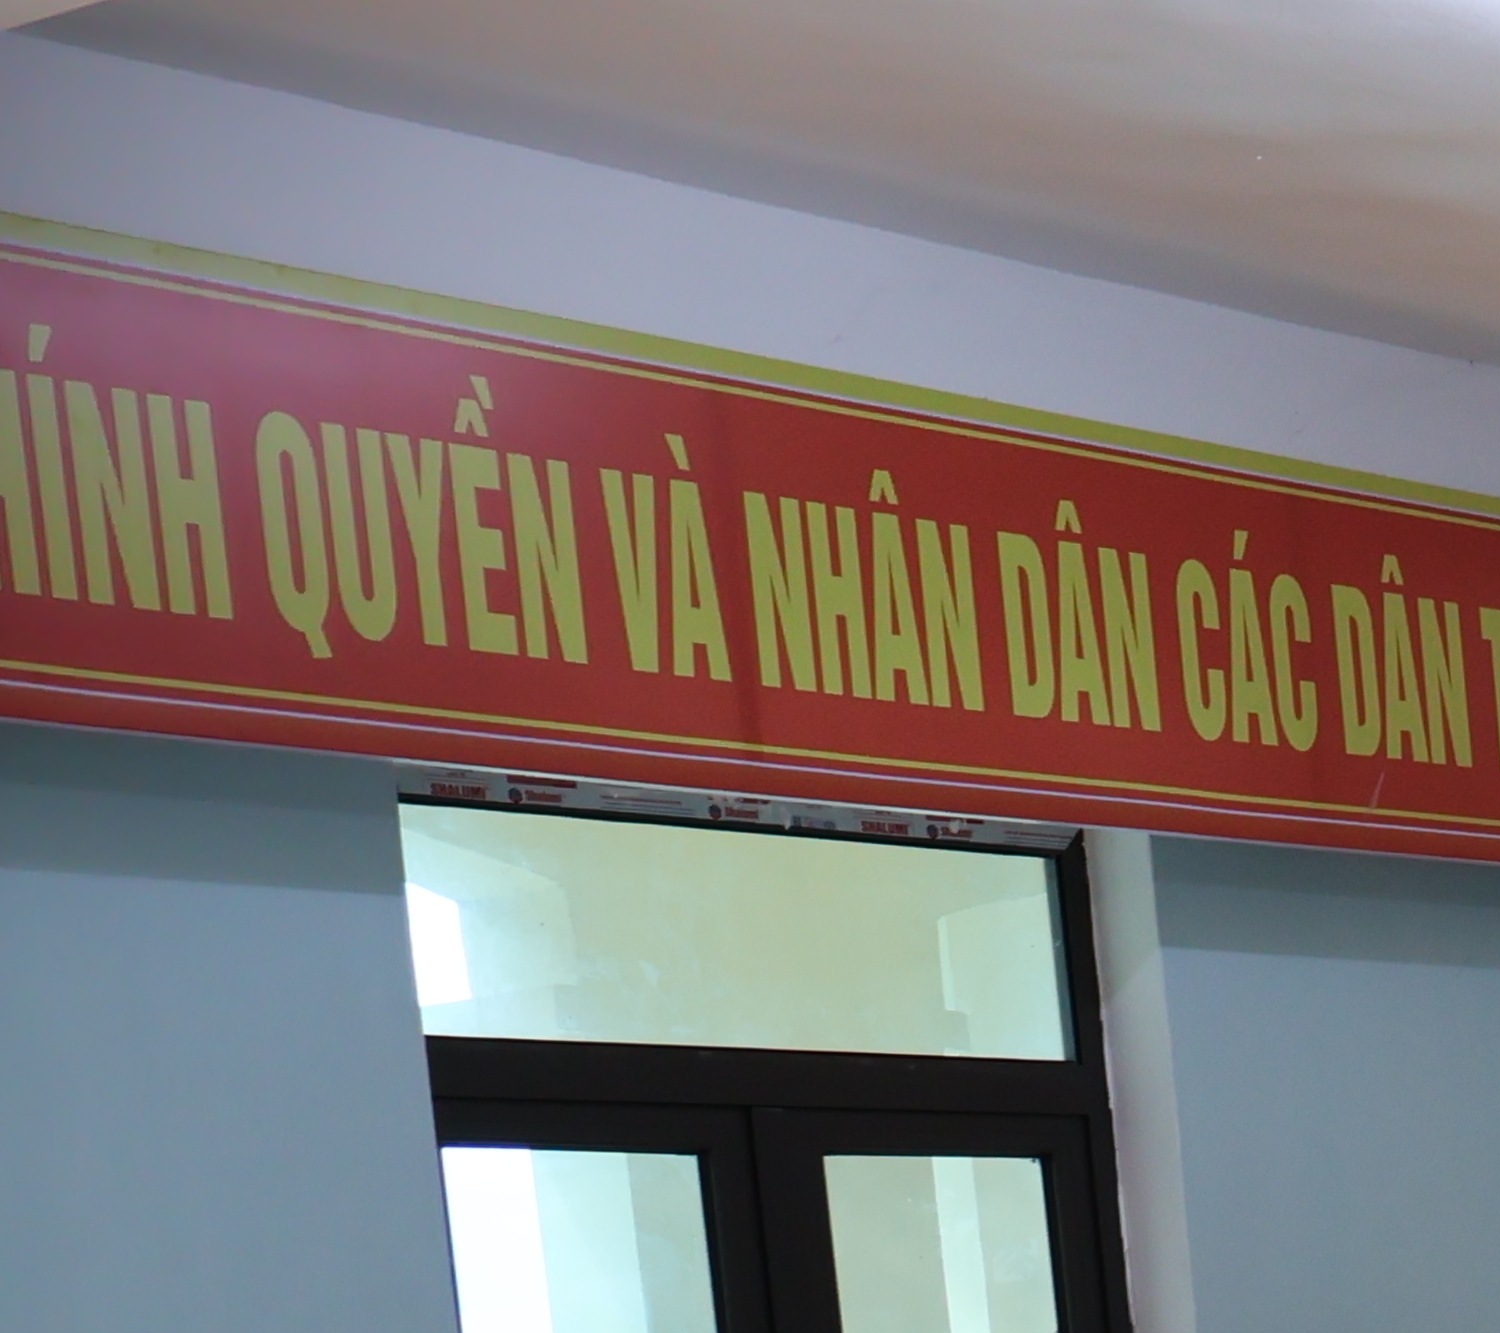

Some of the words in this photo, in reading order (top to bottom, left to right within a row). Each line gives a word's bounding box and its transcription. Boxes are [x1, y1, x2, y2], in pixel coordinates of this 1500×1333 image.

[255, 376, 588, 664] QUYỀN
[600, 433, 732, 682] VÀ
[744, 469, 985, 712] NHÂN
[998, 500, 1161, 731] DÂN
[1176, 530, 1317, 752] CÁC
[1331, 554, 1472, 767] DÂN
